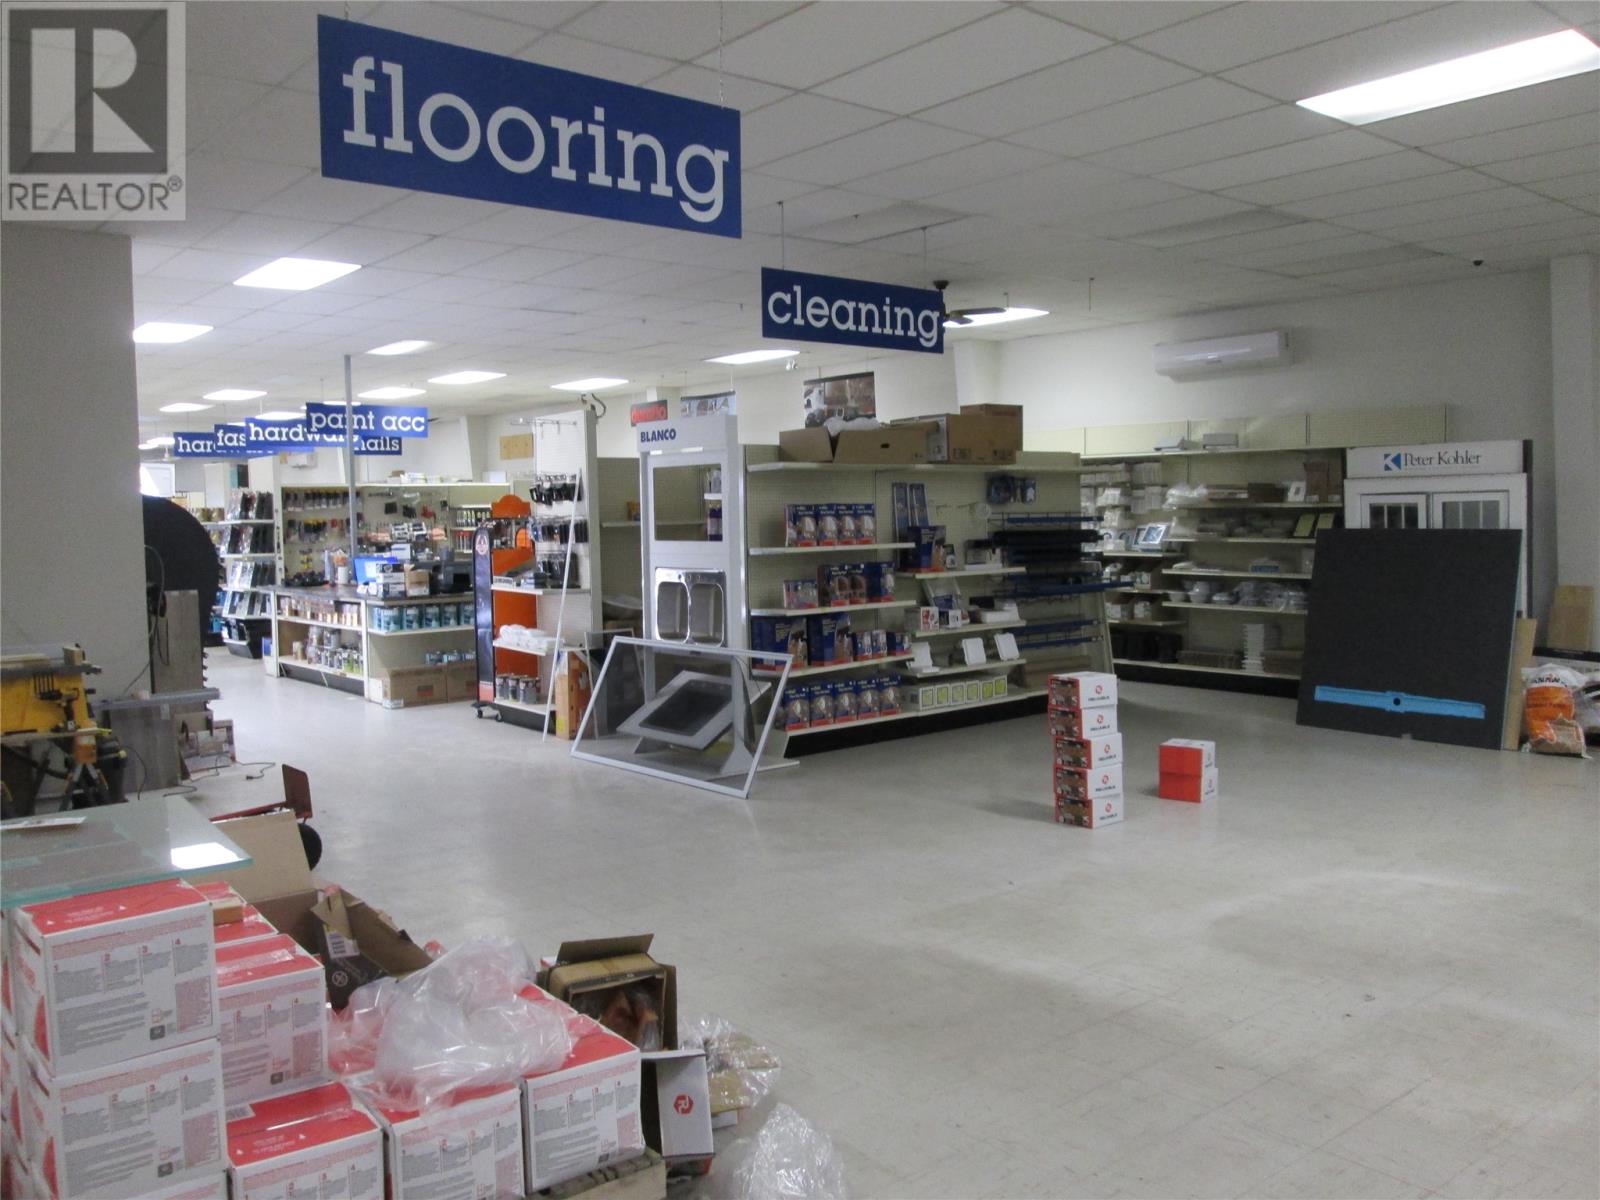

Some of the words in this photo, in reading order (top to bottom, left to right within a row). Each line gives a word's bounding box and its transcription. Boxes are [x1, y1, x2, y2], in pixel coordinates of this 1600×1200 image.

[342, 56, 729, 223] flooring
[767, 284, 940, 348] cleaning
[310, 410, 376, 433] pant
[381, 415, 426, 432] acc
[217, 429, 247, 447] fas
[249, 422, 360, 443] hardw
[640, 428, 677, 443] BLANCO
[177, 436, 217, 453] har
[1404, 452, 1435, 467] Peter
[1438, 449, 1482, 466] Kohler
